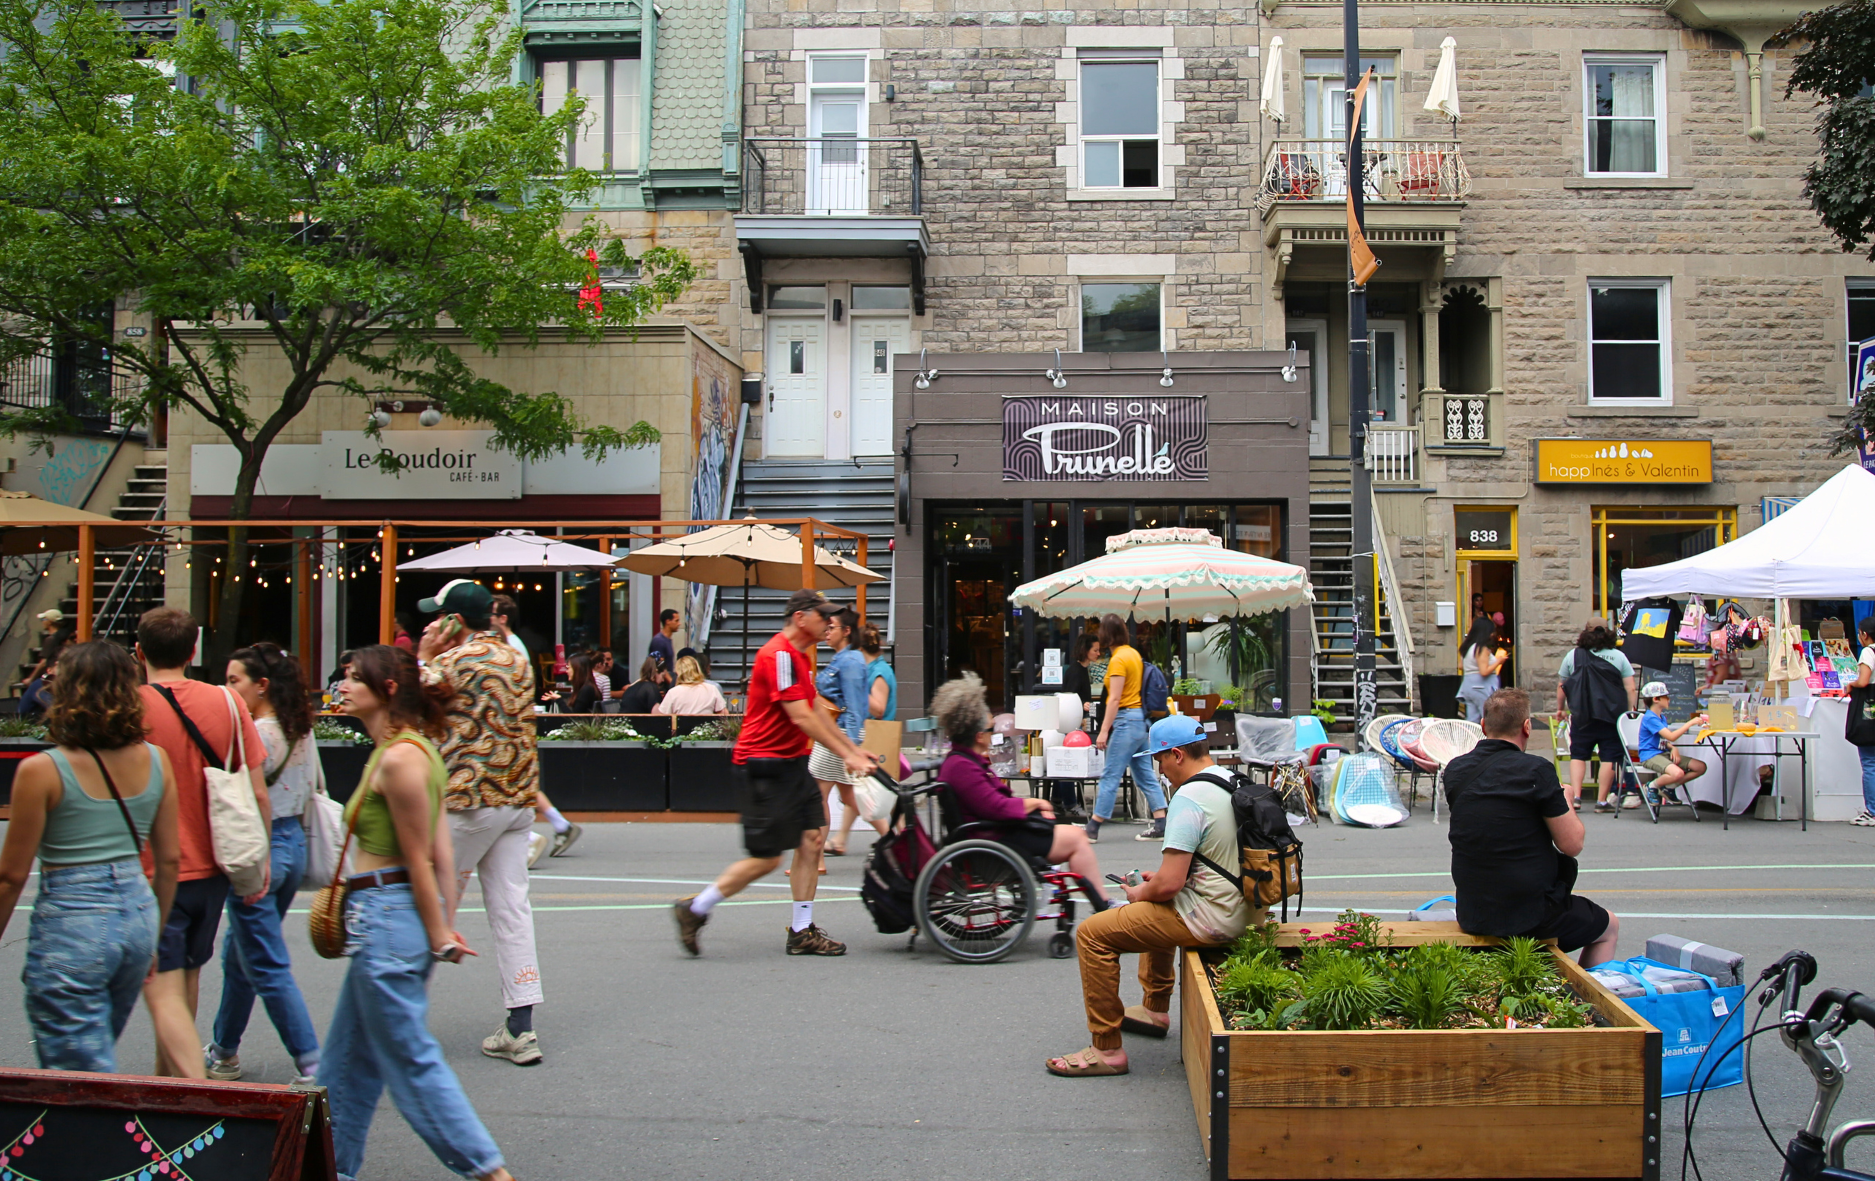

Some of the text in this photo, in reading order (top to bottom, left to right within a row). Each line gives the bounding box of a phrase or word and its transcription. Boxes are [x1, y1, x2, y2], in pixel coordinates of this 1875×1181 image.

[1041, 402, 1167, 416] MAISON
[345, 449, 370, 468] Le
[450, 470, 500, 482] CAFÉ BAR
[1625, 463, 1635, 476] &
[1641, 463, 1699, 477] Valentin
[1470, 530, 1498, 542] 838
[1662, 1048, 1683, 1057] Jean
